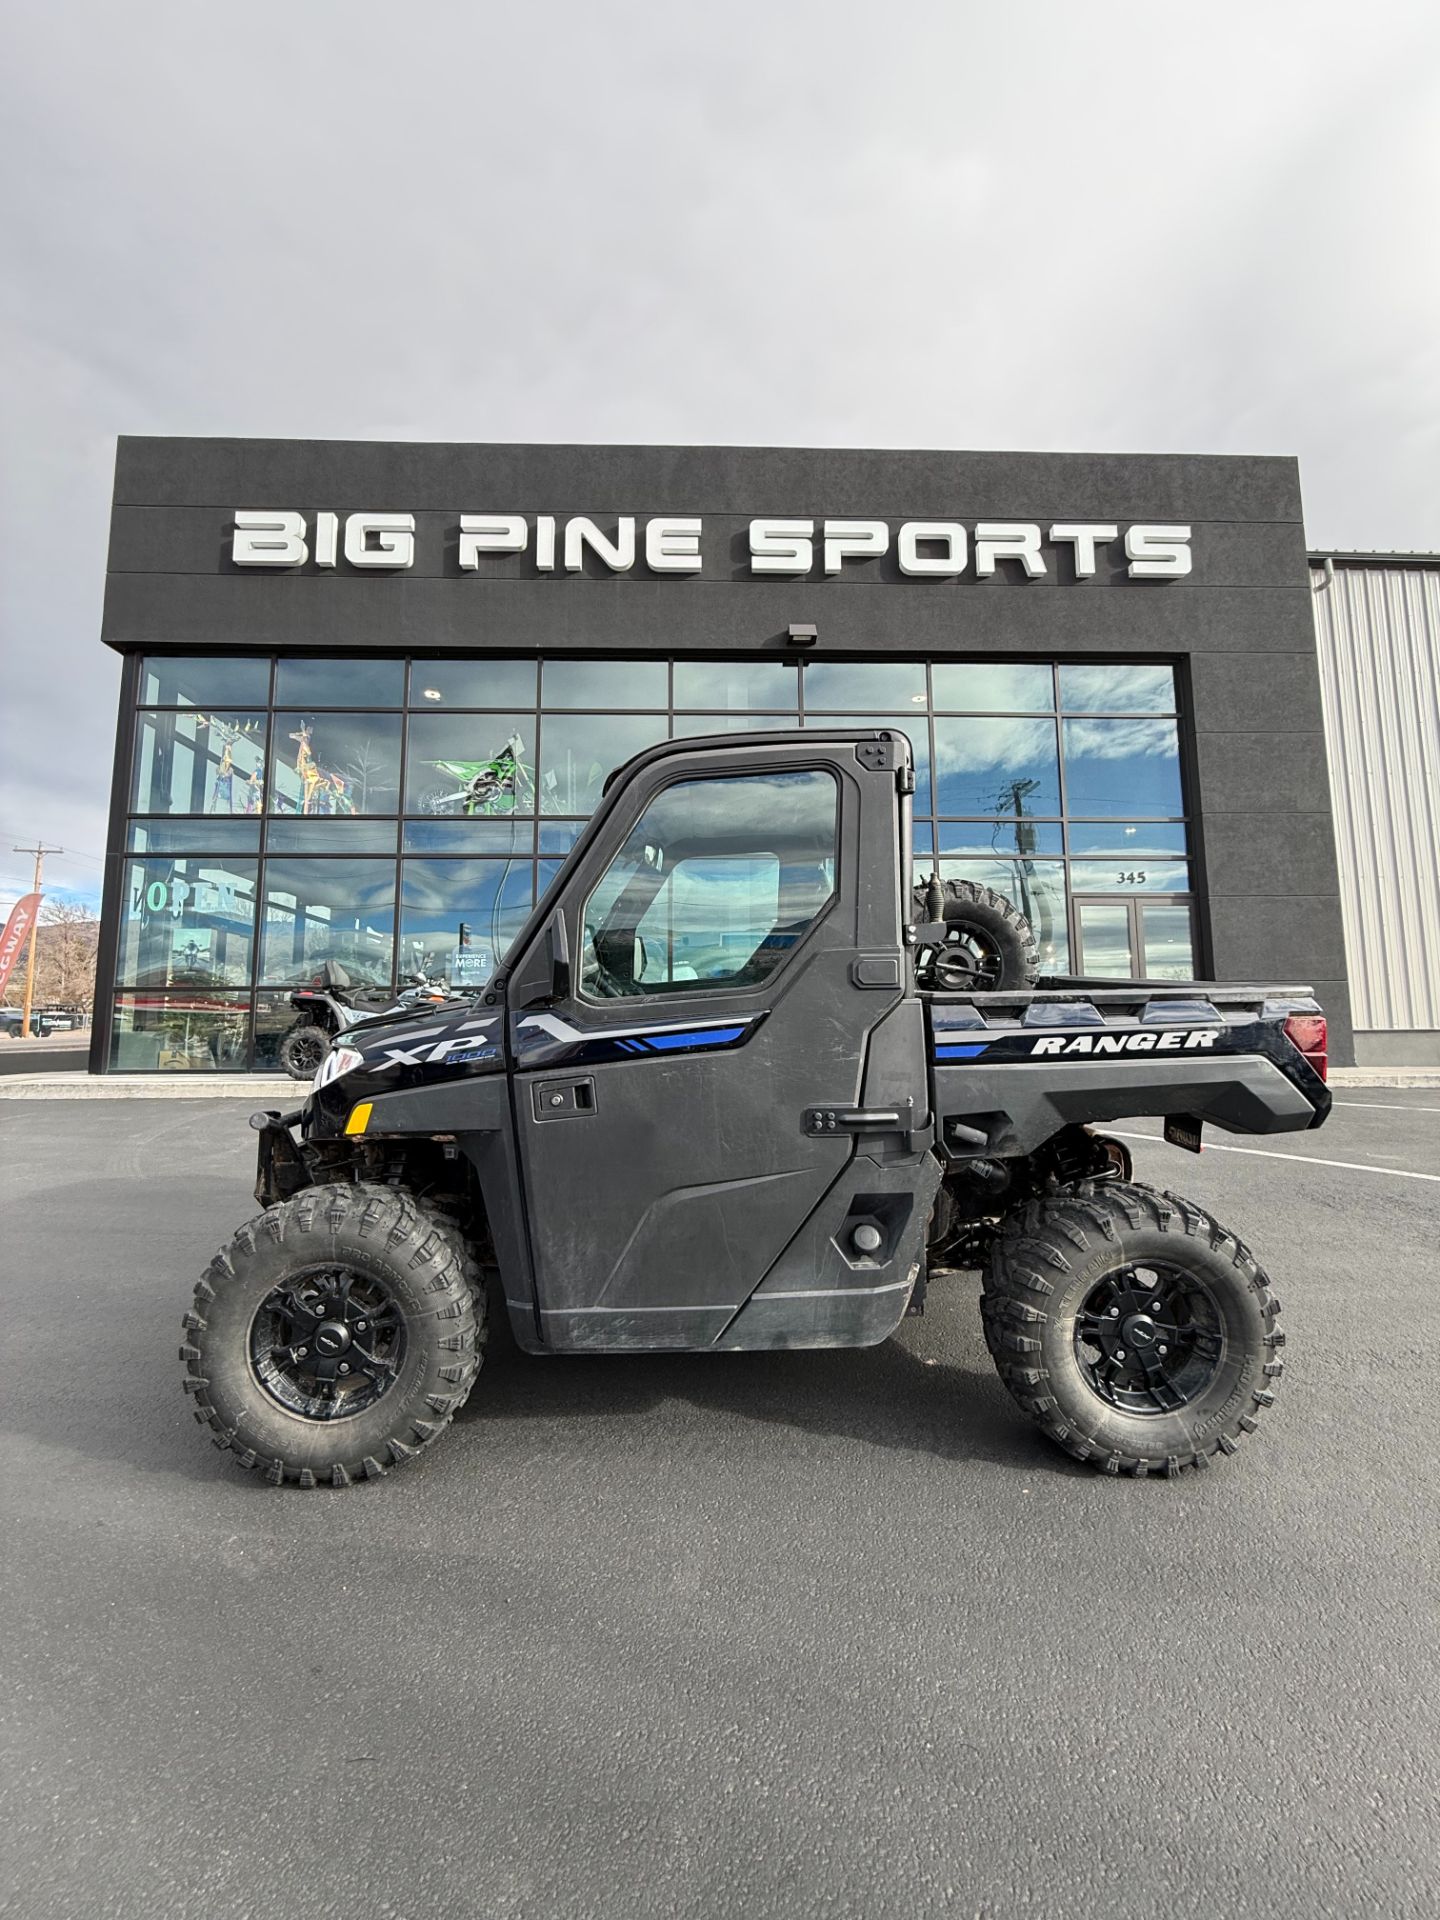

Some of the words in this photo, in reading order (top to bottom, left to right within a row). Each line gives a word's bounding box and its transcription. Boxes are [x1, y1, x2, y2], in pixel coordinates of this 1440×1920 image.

[232, 511, 416, 568] BIG
[458, 514, 703, 573] PINE
[748, 519, 1192, 578] SPORTS
[1116, 871, 1147, 884] 345
[147, 880, 236, 913] OPEN
[368, 1034, 489, 1074] XP
[446, 1048, 497, 1062] 1000
[1030, 1030, 1220, 1056] RANGER
